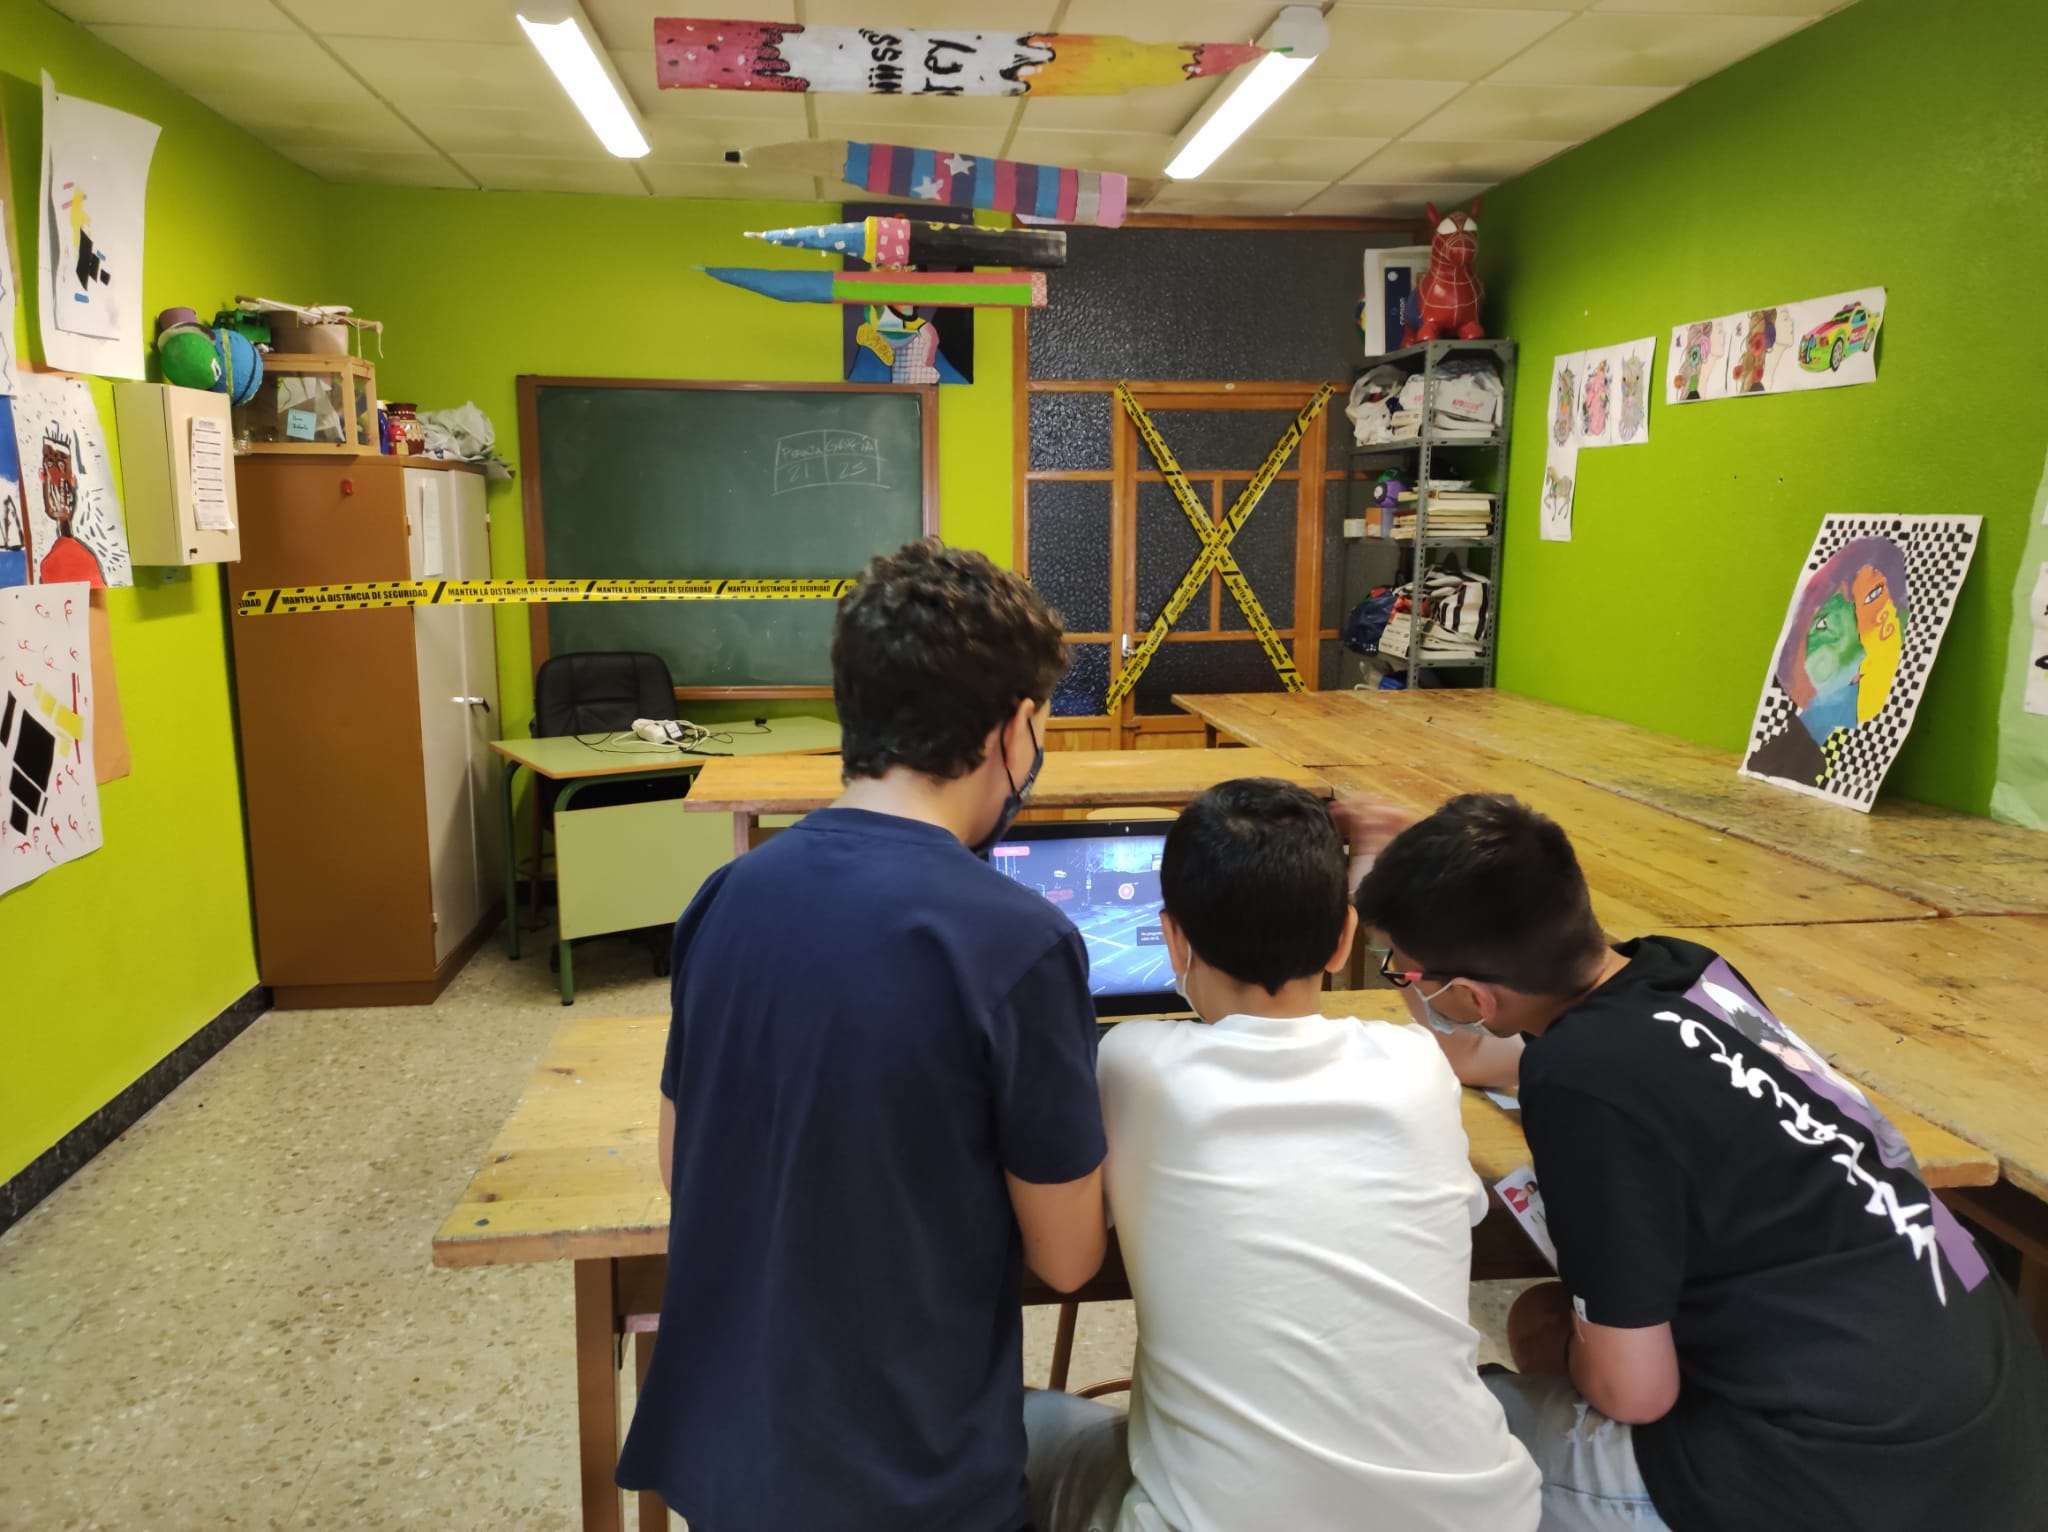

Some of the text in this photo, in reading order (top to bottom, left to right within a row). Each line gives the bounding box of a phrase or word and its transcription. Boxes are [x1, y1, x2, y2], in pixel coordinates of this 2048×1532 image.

[448, 587, 478, 597] MANTEN
[479, 587, 489, 596] LA
[490, 587, 528, 596] DISTANCIA
[727, 585, 751, 593] MANTEN
[752, 585, 759, 593] LA
[282, 589, 428, 605] MANTEN LA DISTANCIA DE SEGURIDAD
